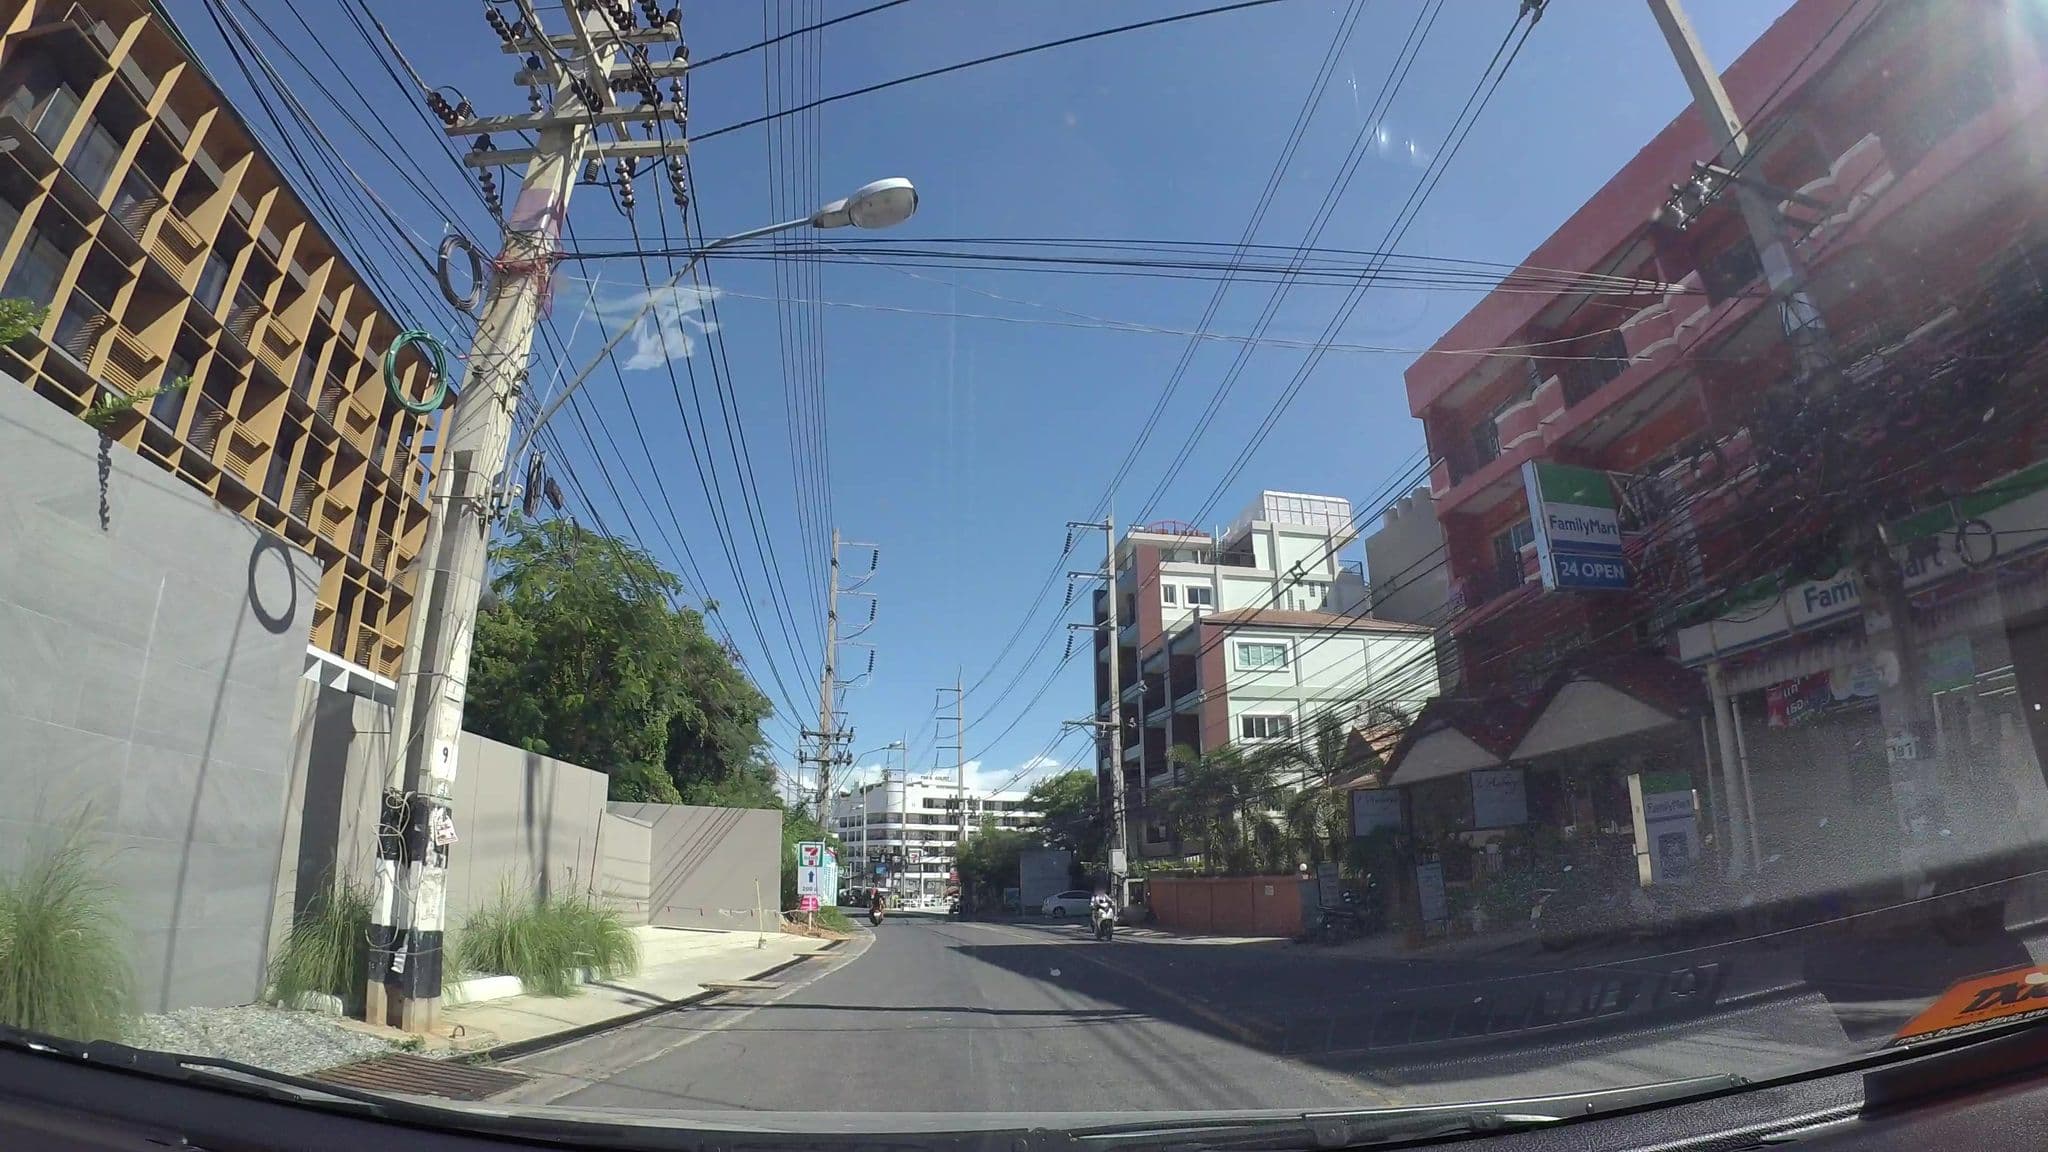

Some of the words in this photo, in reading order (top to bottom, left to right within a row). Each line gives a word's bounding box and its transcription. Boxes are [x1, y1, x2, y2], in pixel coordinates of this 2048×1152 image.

[1549, 515, 1617, 535] FamilyMart
[1559, 561, 1578, 577] 24
[1581, 562, 1625, 579] OPEN
[442, 747, 449, 763] 9
